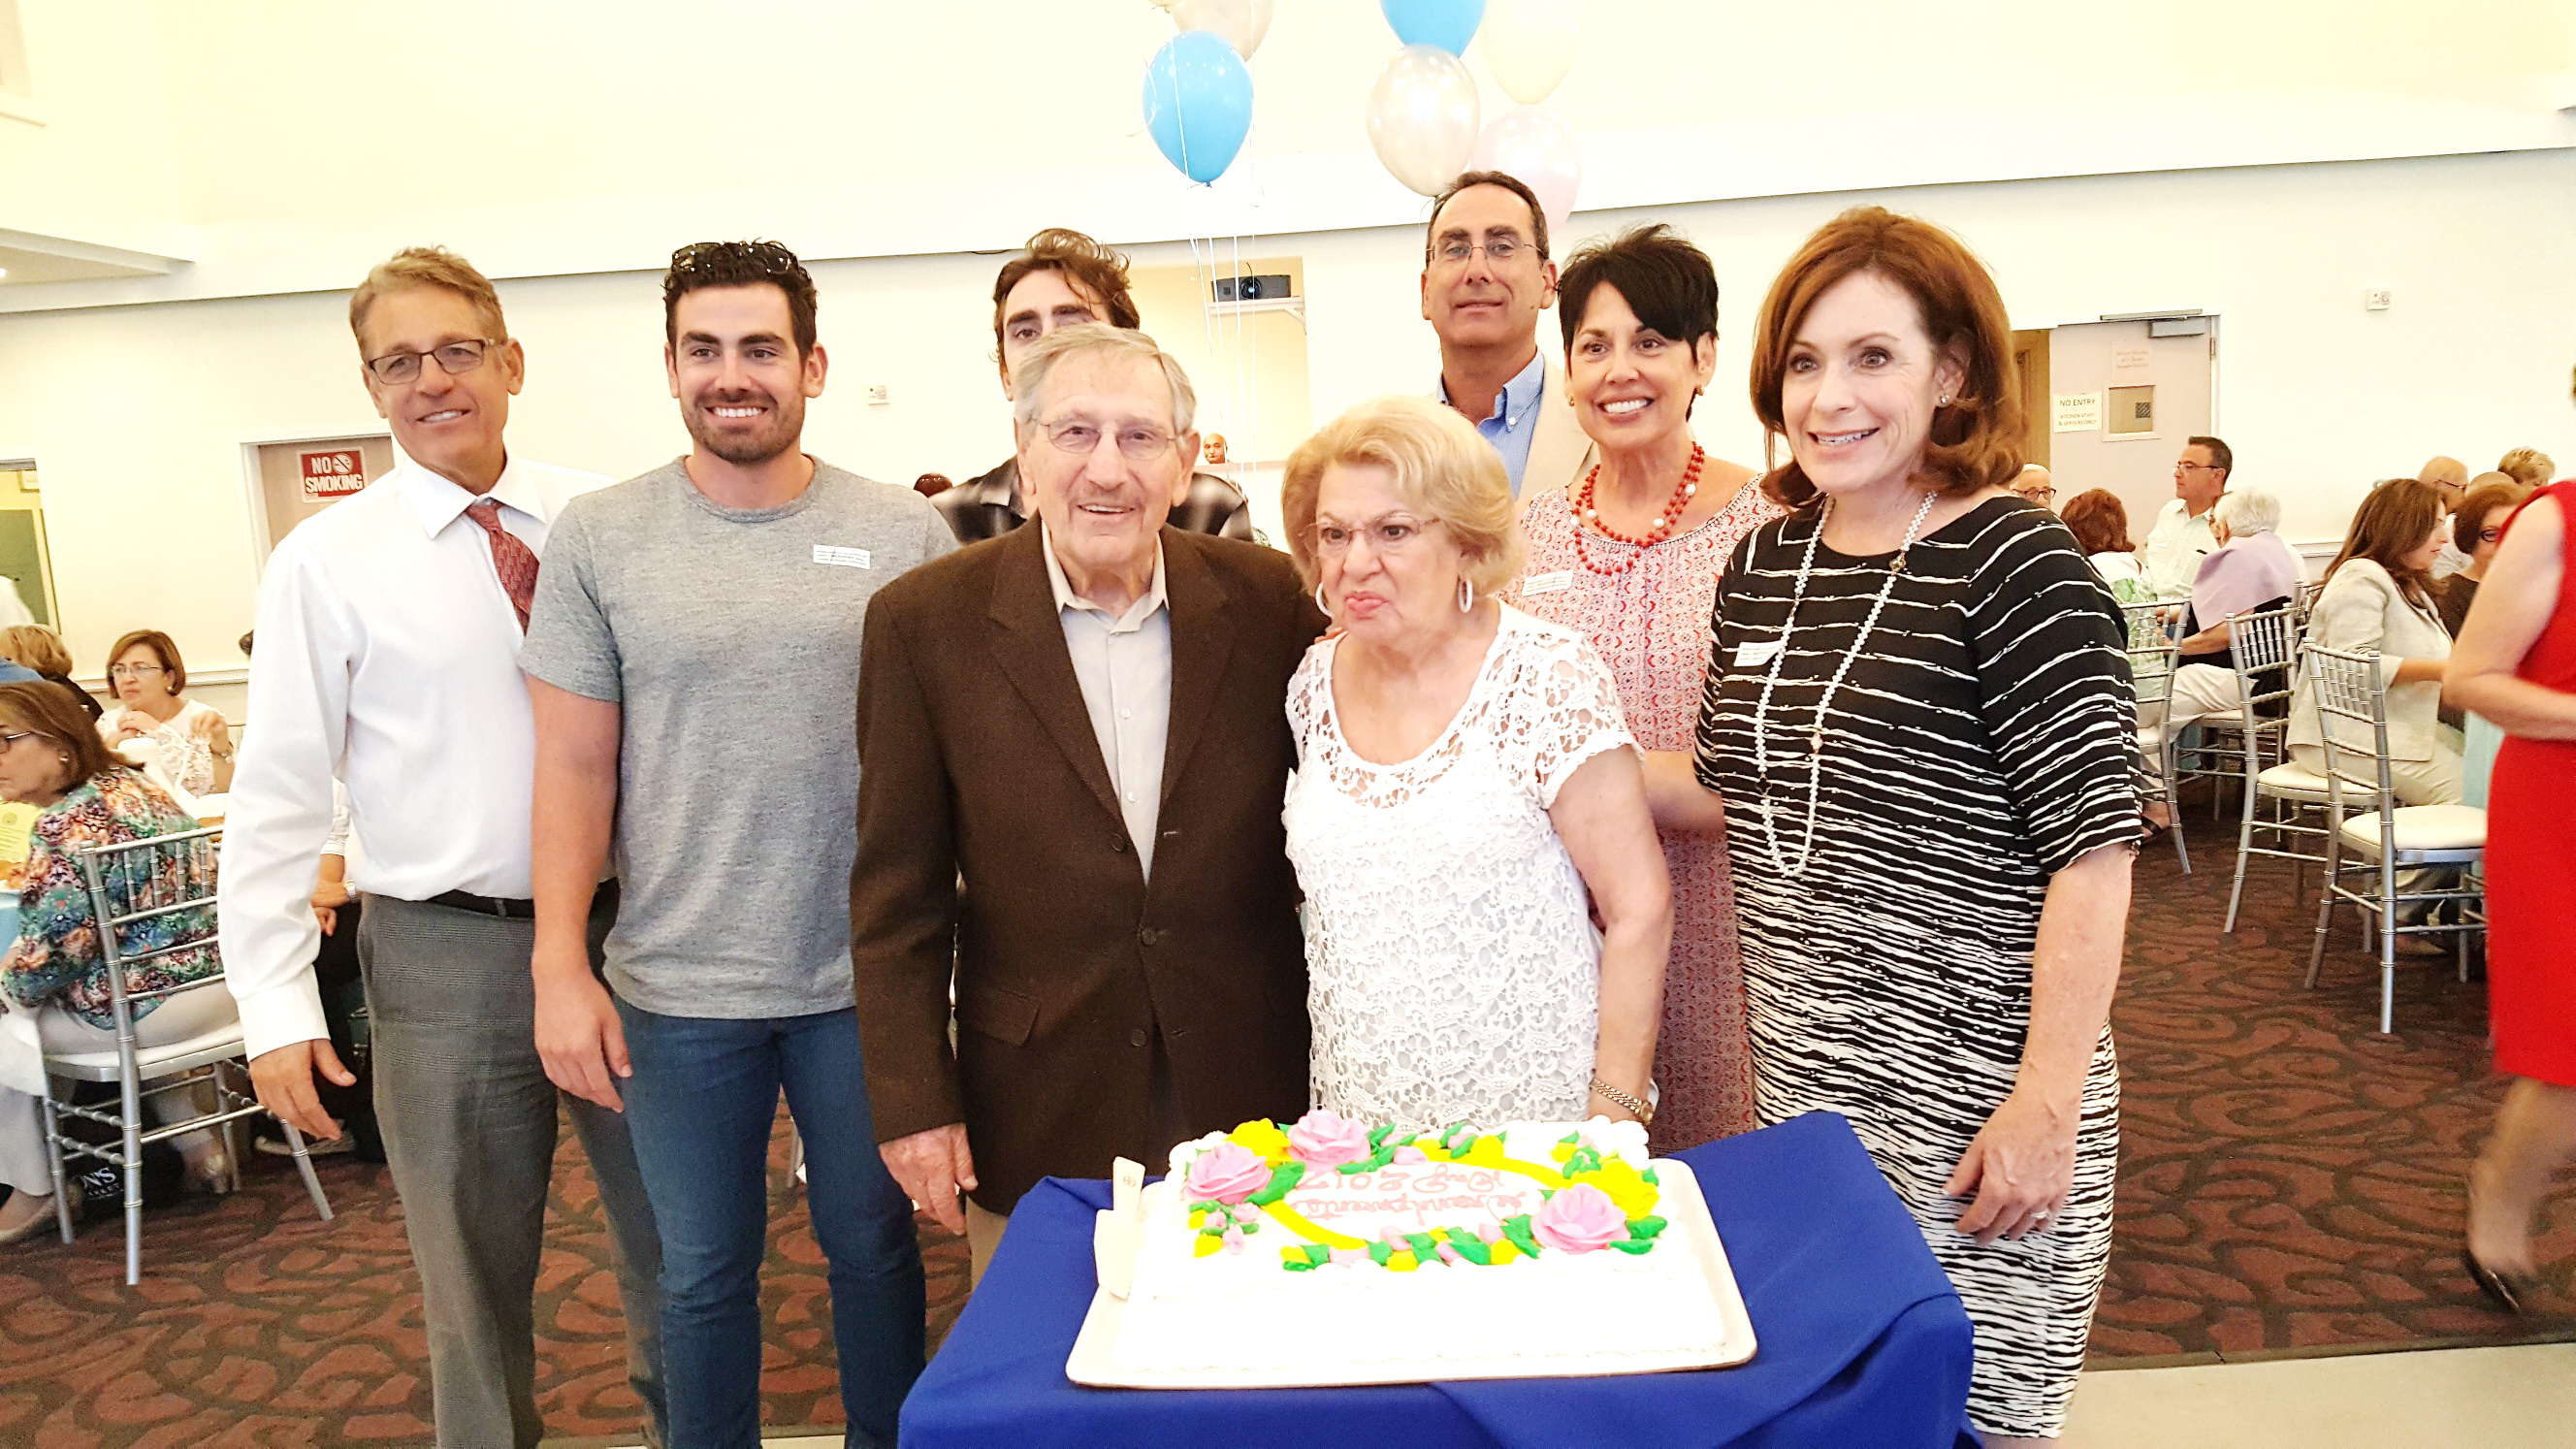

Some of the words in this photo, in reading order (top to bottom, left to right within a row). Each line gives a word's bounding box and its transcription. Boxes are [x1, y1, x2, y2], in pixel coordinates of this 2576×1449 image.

[311, 456, 332, 474] NO
[305, 473, 363, 494] SMOKING
[1294, 1169, 1411, 1191] 2017
